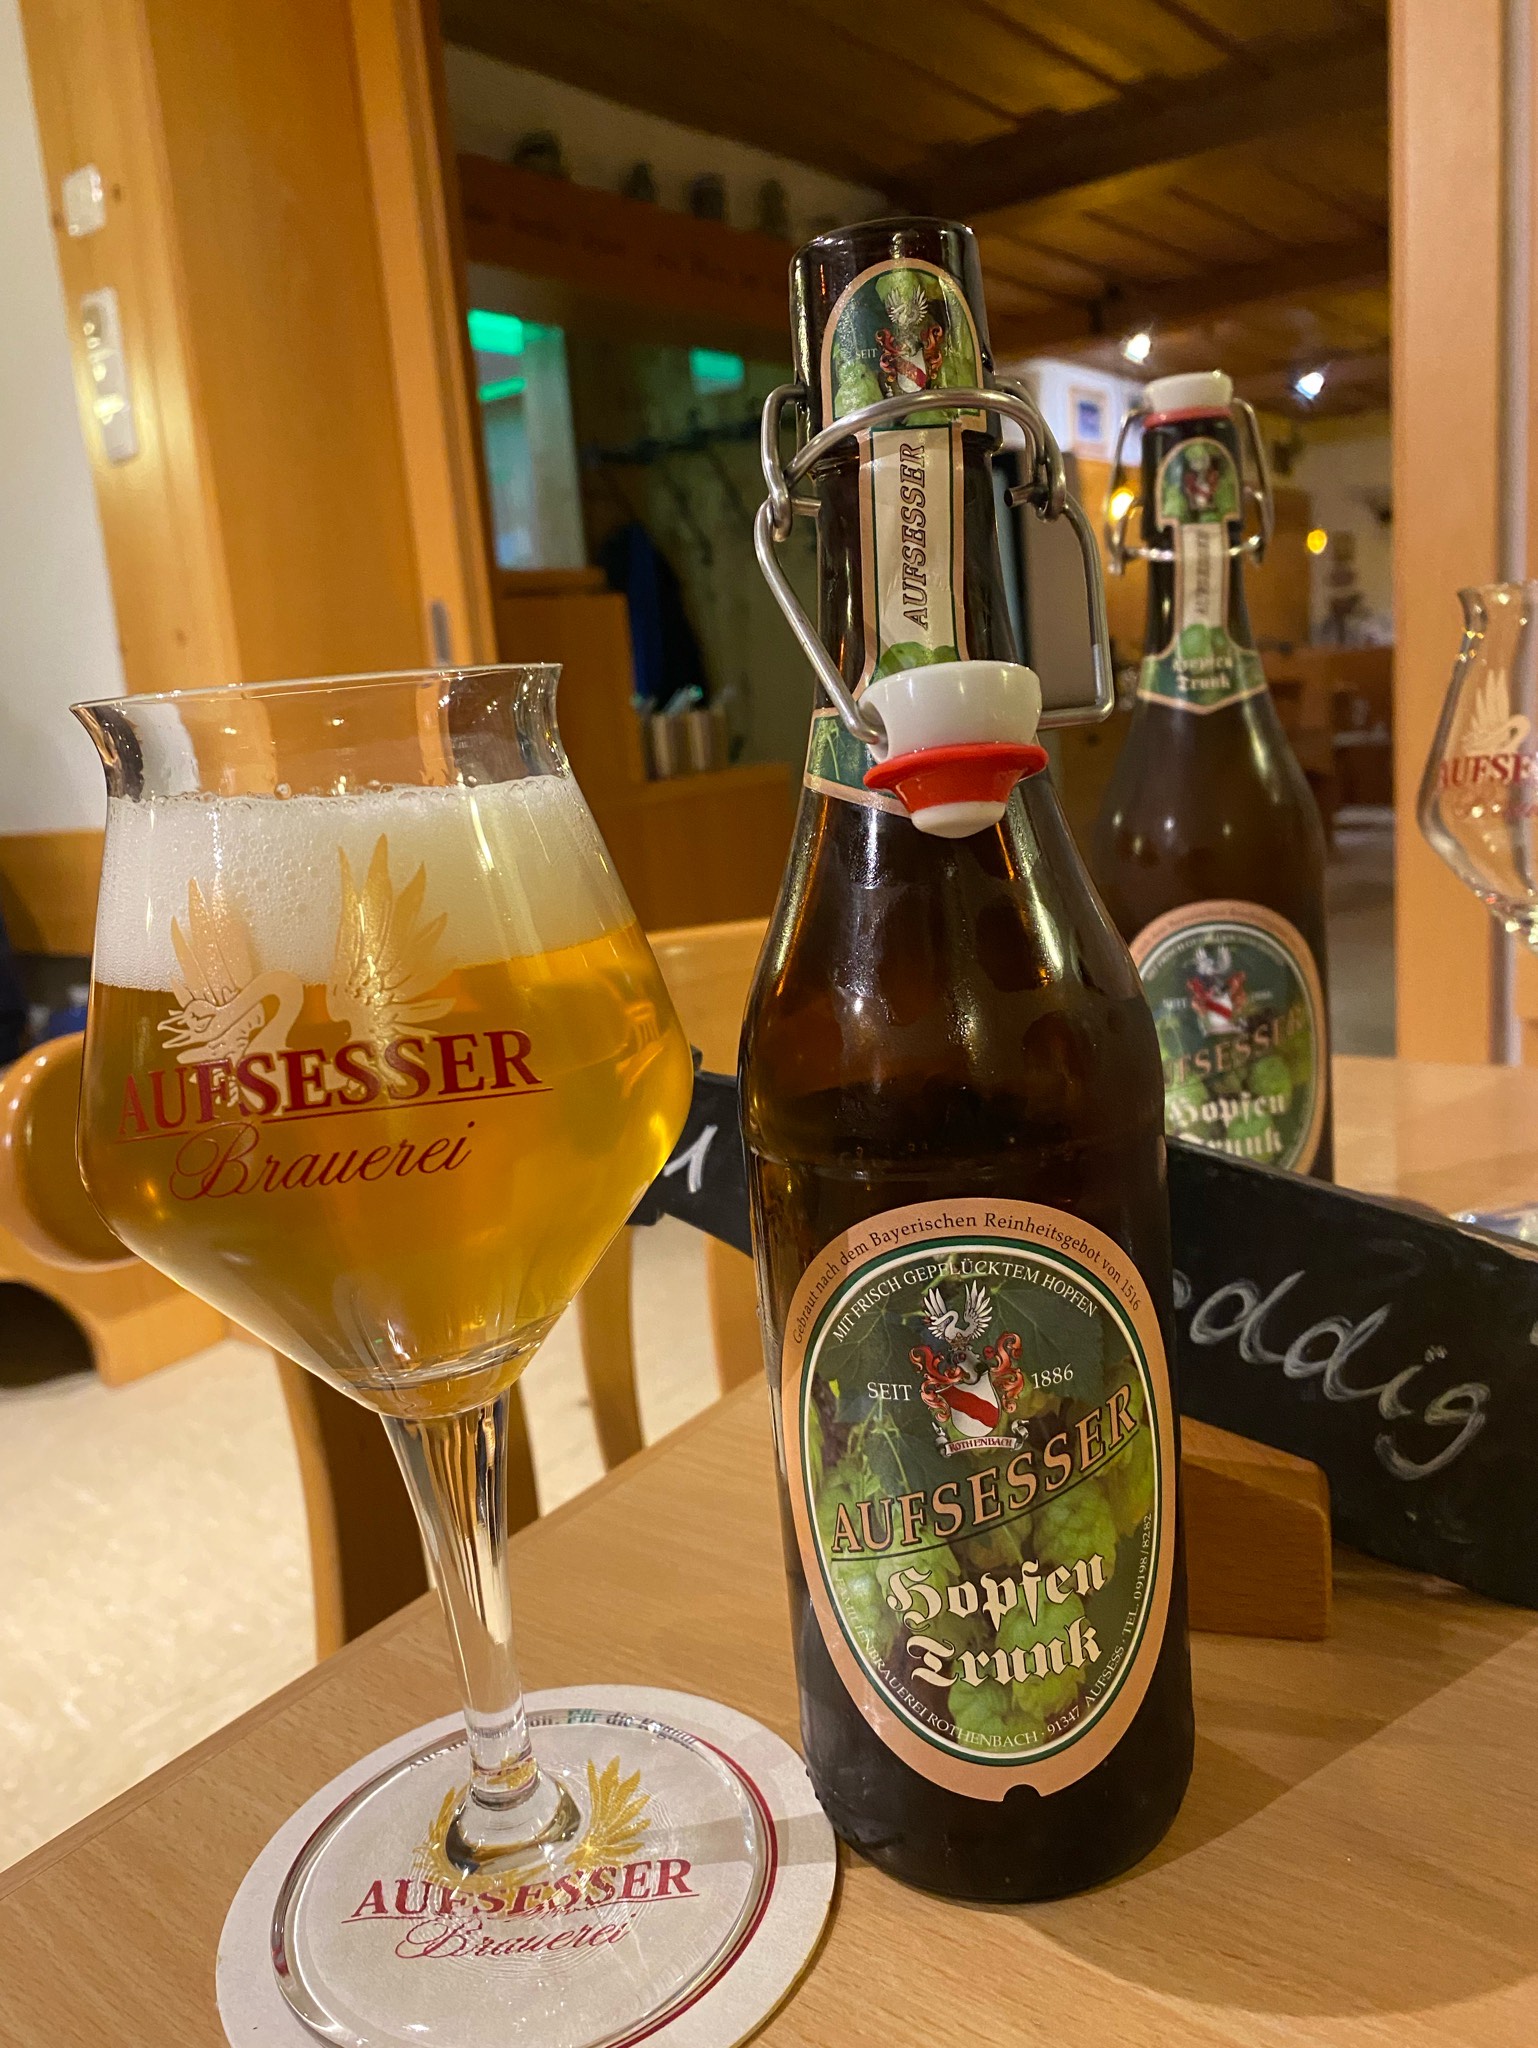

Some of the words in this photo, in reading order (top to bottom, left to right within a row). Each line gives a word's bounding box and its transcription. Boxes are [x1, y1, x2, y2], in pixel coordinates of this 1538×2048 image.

[902, 443, 930, 631] AUFSESSER
[117, 1028, 543, 1135] AUFSESSER
[169, 1120, 476, 1201] Brauerei
[793, 1291, 819, 1344] Gebraut
[815, 1263, 840, 1294] nach
[840, 1242, 870, 1266] dem
[868, 1212, 978, 1246] Bayerischen
[985, 1212, 1101, 1263] Reinheitsgebot
[1102, 1258, 1122, 1284] von
[1120, 1279, 1143, 1312] 1516
[832, 1316, 857, 1344] MIT
[850, 1276, 902, 1319] FRISCH
[903, 1258, 1041, 1286] GEPFLÜCKTEM
[1040, 1273, 1099, 1318] HOPFEN
[867, 1381, 913, 1401] SEIT
[1031, 1366, 1075, 1390] 1886
[831, 1383, 1138, 1553] AUFSESSER
[948, 1437, 1013, 1453] ROTHENBACH
[886, 1552, 1108, 1633] Hopfen
[834, 1576, 930, 1718] FAMILIENBRAUEREI
[926, 1712, 1039, 1748] ROTHENBACH
[1046, 1705, 1081, 1736] 91347
[1084, 1645, 1125, 1709] AUFSESS
[906, 1615, 1102, 1688] Trunk
[350, 1857, 694, 1918] AUFSESSER
[395, 1911, 638, 1960] Brauerei
